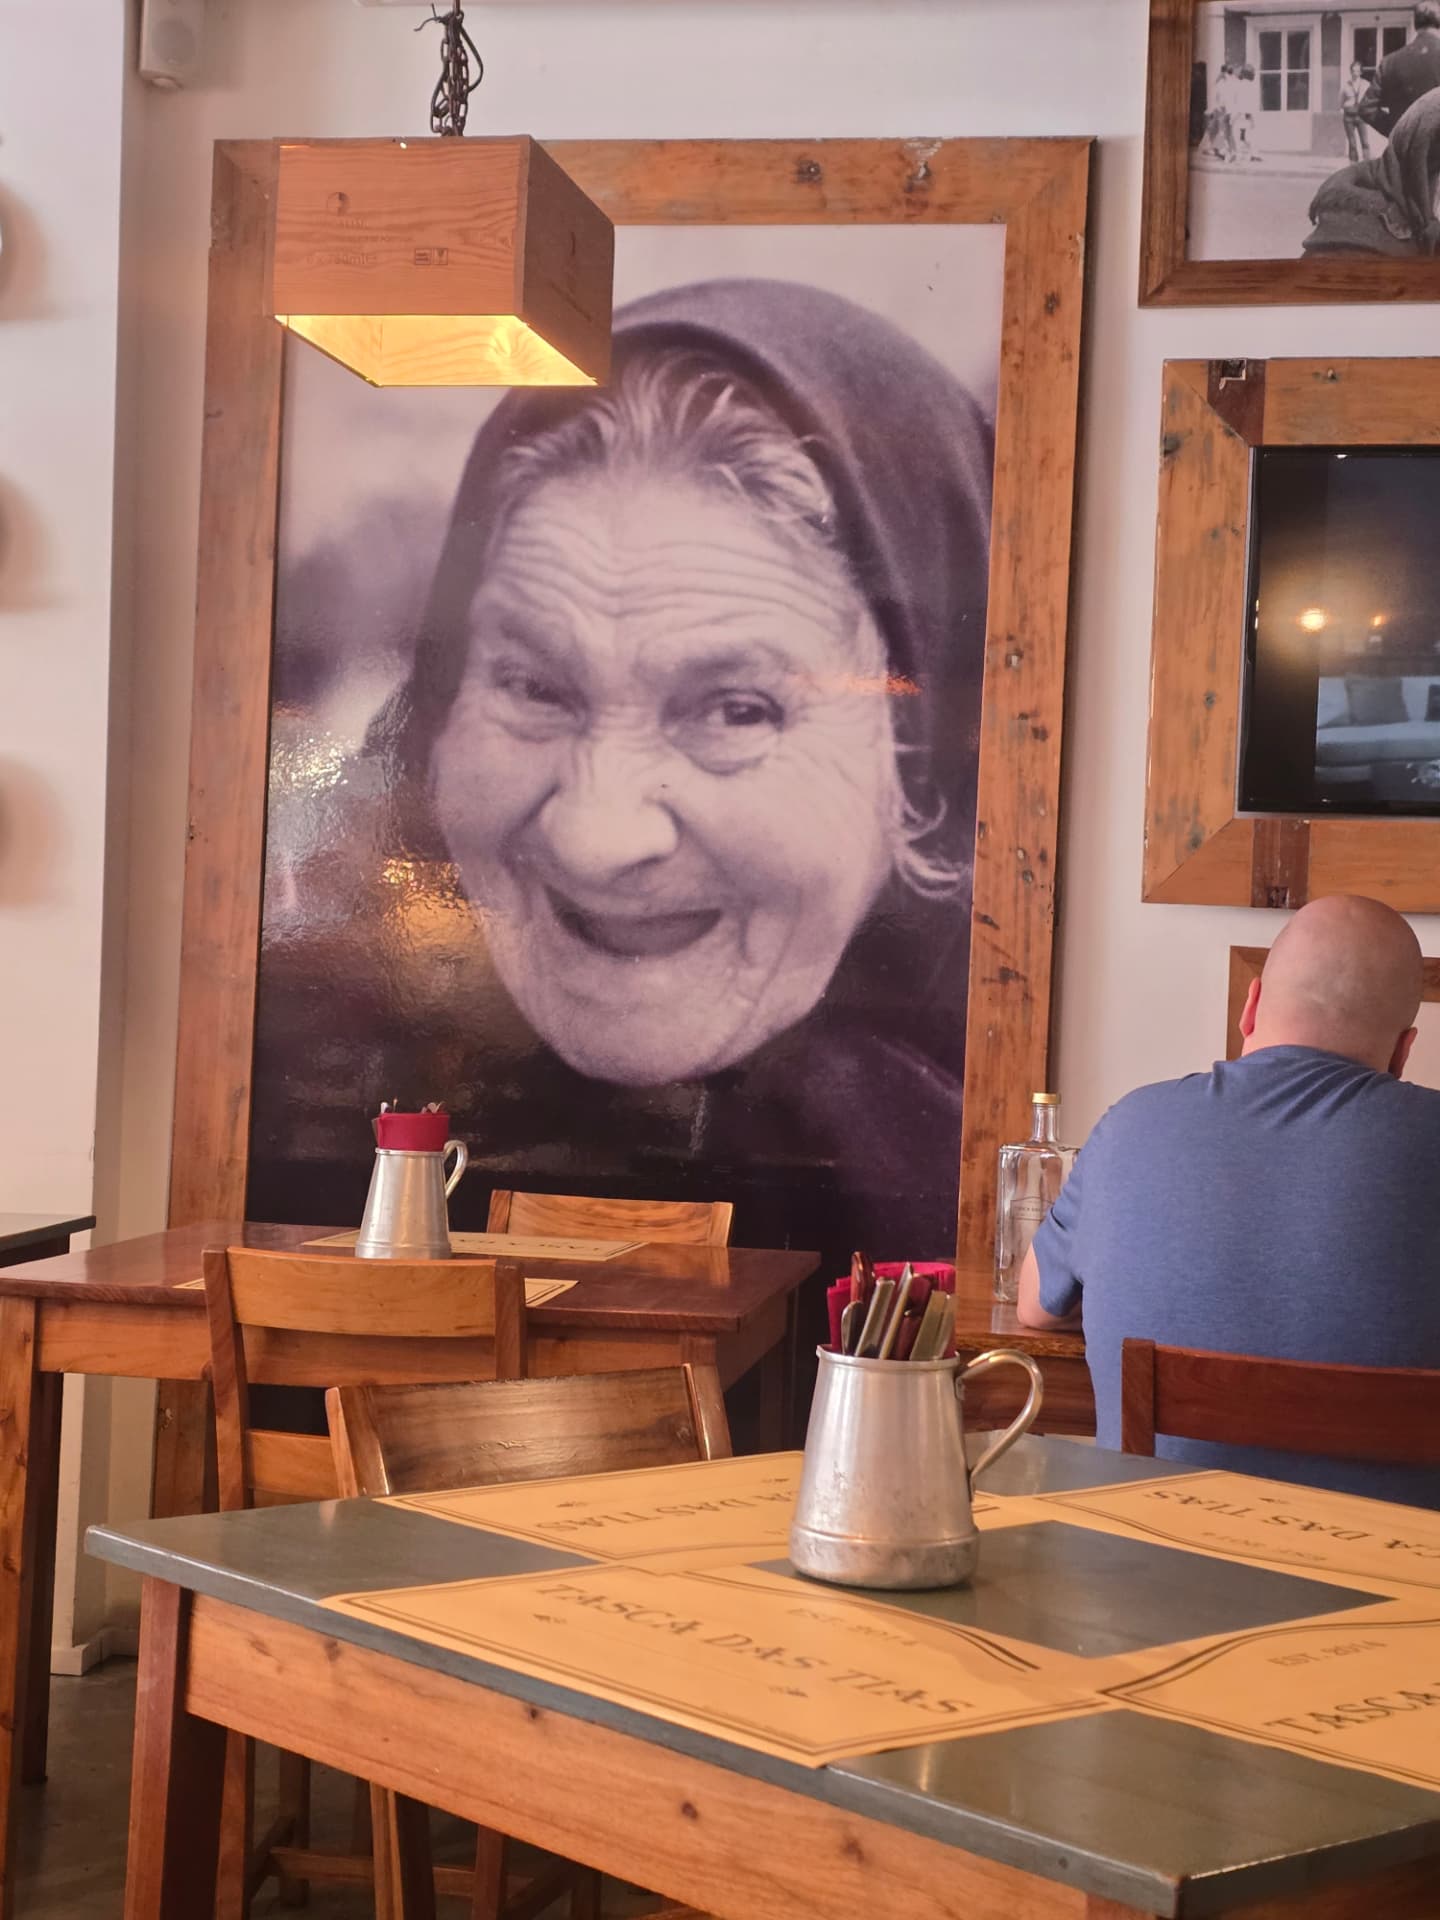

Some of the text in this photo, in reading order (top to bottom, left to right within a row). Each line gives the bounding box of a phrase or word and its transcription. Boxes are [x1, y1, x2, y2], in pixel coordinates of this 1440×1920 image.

[536, 1511, 664, 1531] TIAS
[1143, 1490, 1374, 1542] DAS TIAS
[535, 1584, 977, 1715] TASCA DAS TIAS
[1262, 1689, 1440, 1735] TASCA
